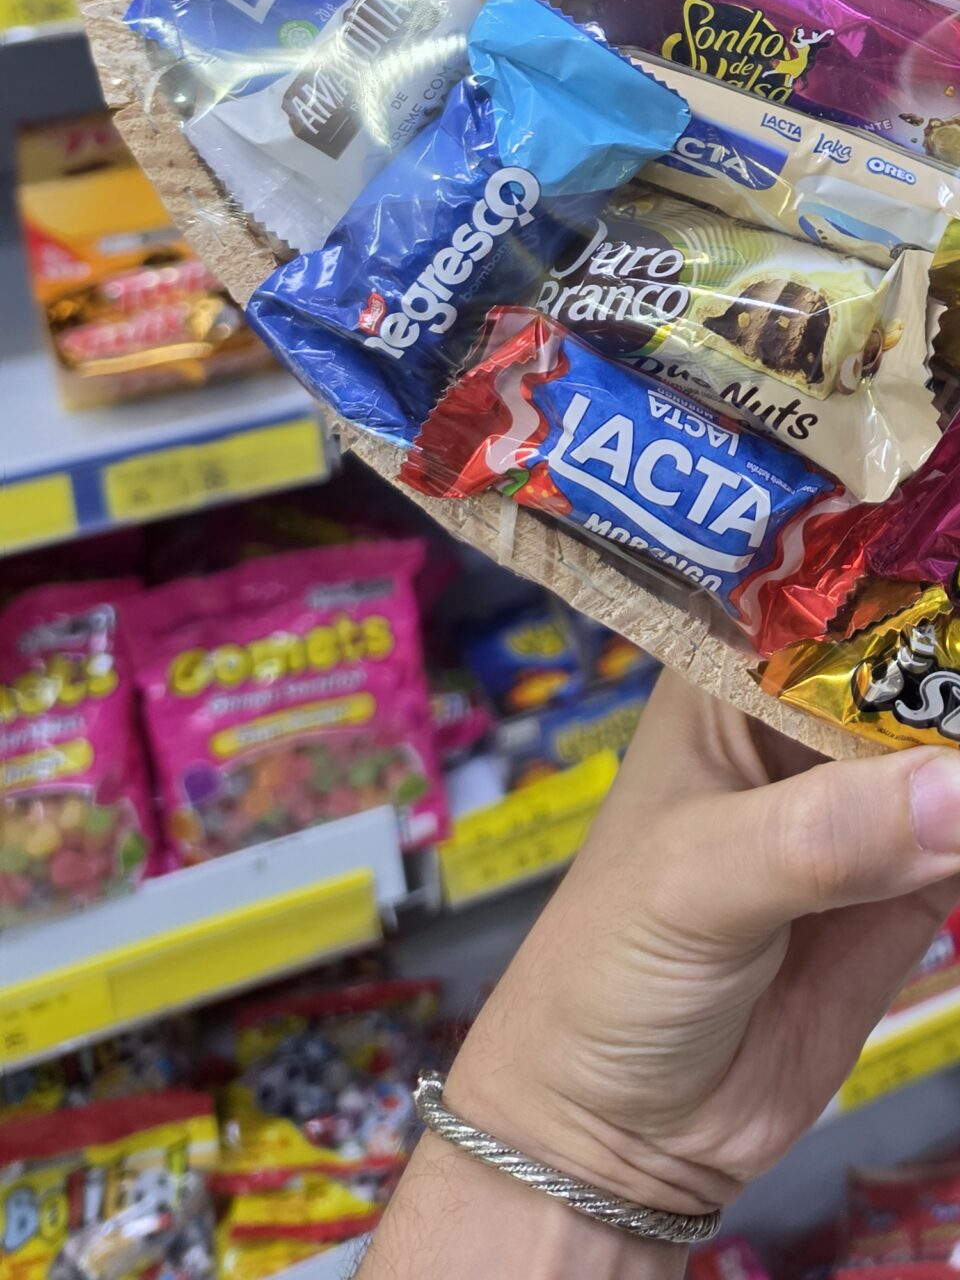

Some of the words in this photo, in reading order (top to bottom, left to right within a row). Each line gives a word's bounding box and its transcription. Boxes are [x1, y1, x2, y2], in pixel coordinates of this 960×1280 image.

[729, 56, 754, 76] de
[676, 136, 751, 181] CTA
[760, 112, 803, 141] LACTA
[813, 132, 853, 164] Laka
[868, 157, 916, 185] OREO
[648, 394, 740, 457] LACTA
[719, 382, 819, 440] Nuts
[549, 393, 772, 548] LACTA
